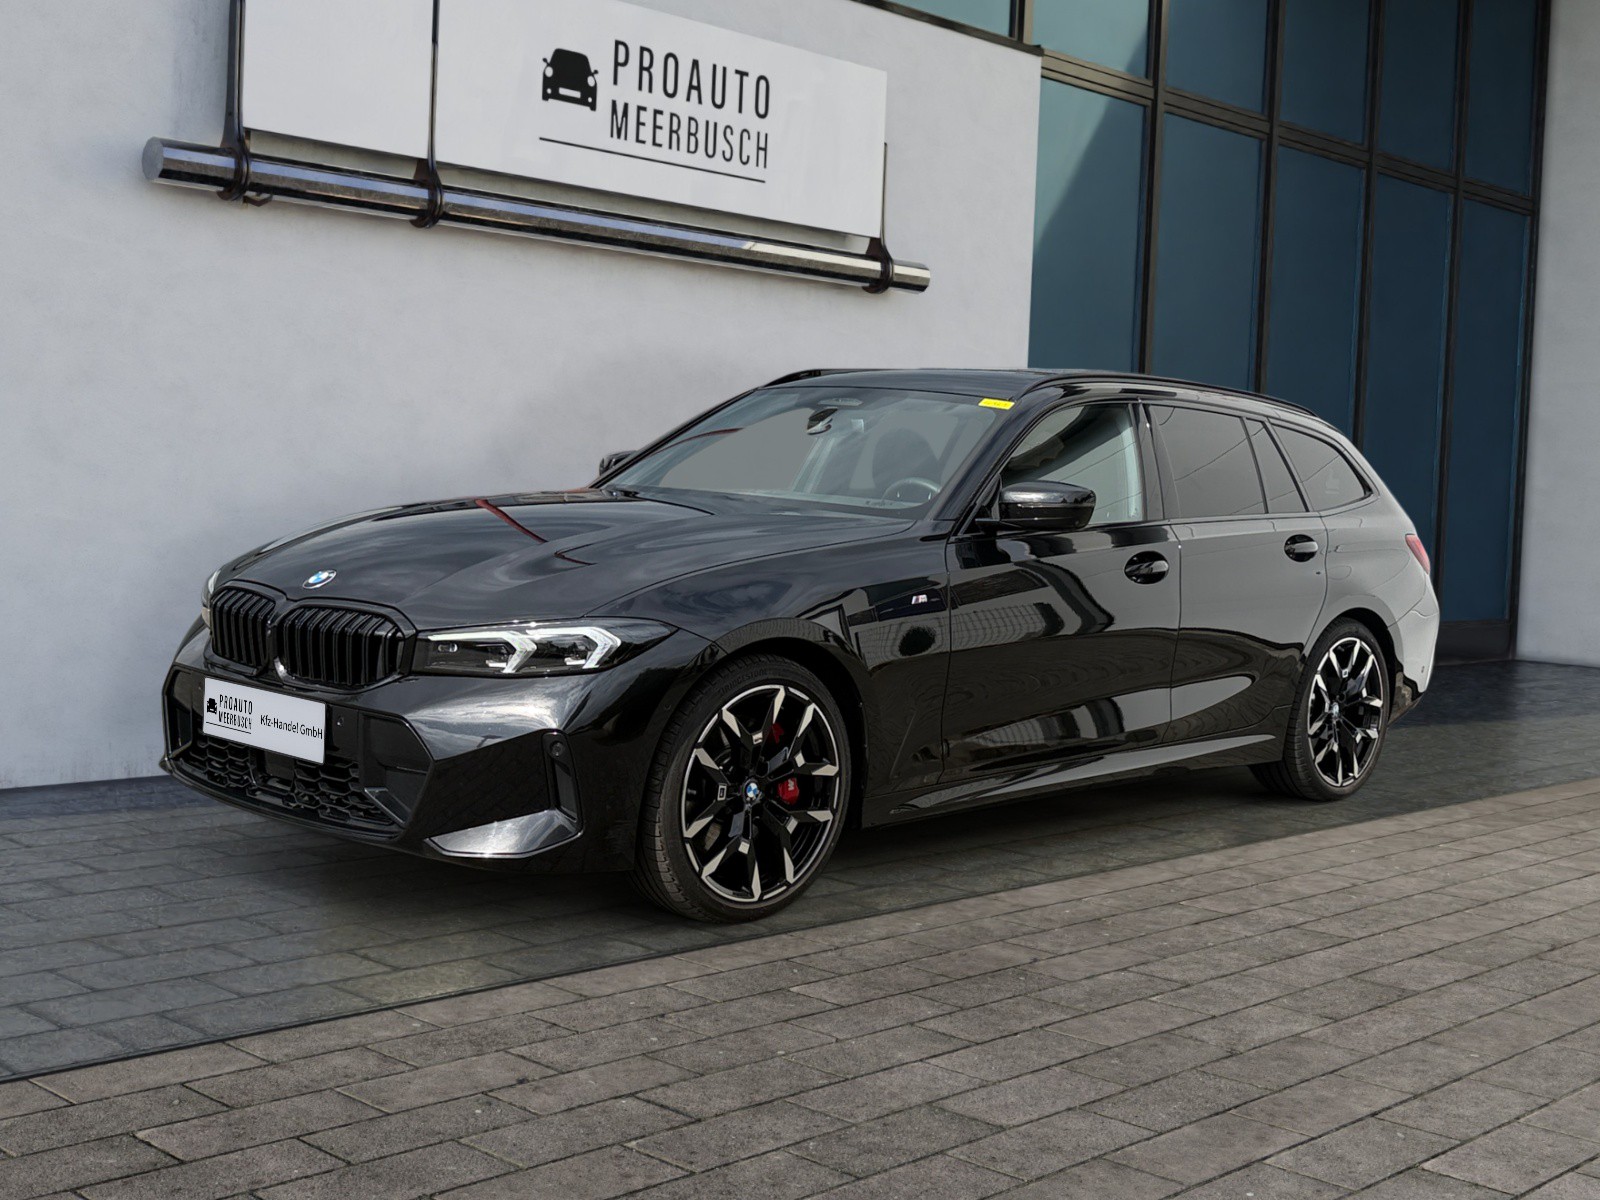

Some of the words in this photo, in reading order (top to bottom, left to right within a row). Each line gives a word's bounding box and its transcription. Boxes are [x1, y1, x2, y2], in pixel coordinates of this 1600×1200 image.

[613, 39, 770, 119] PROAUTO
[610, 100, 768, 169] MEERBUSCH
[219, 694, 253, 715] PROAUTO
[218, 710, 252, 730] MEERBUSCH
[260, 714, 299, 734] Kfz-Handel
[300, 724, 323, 740] GmbH
